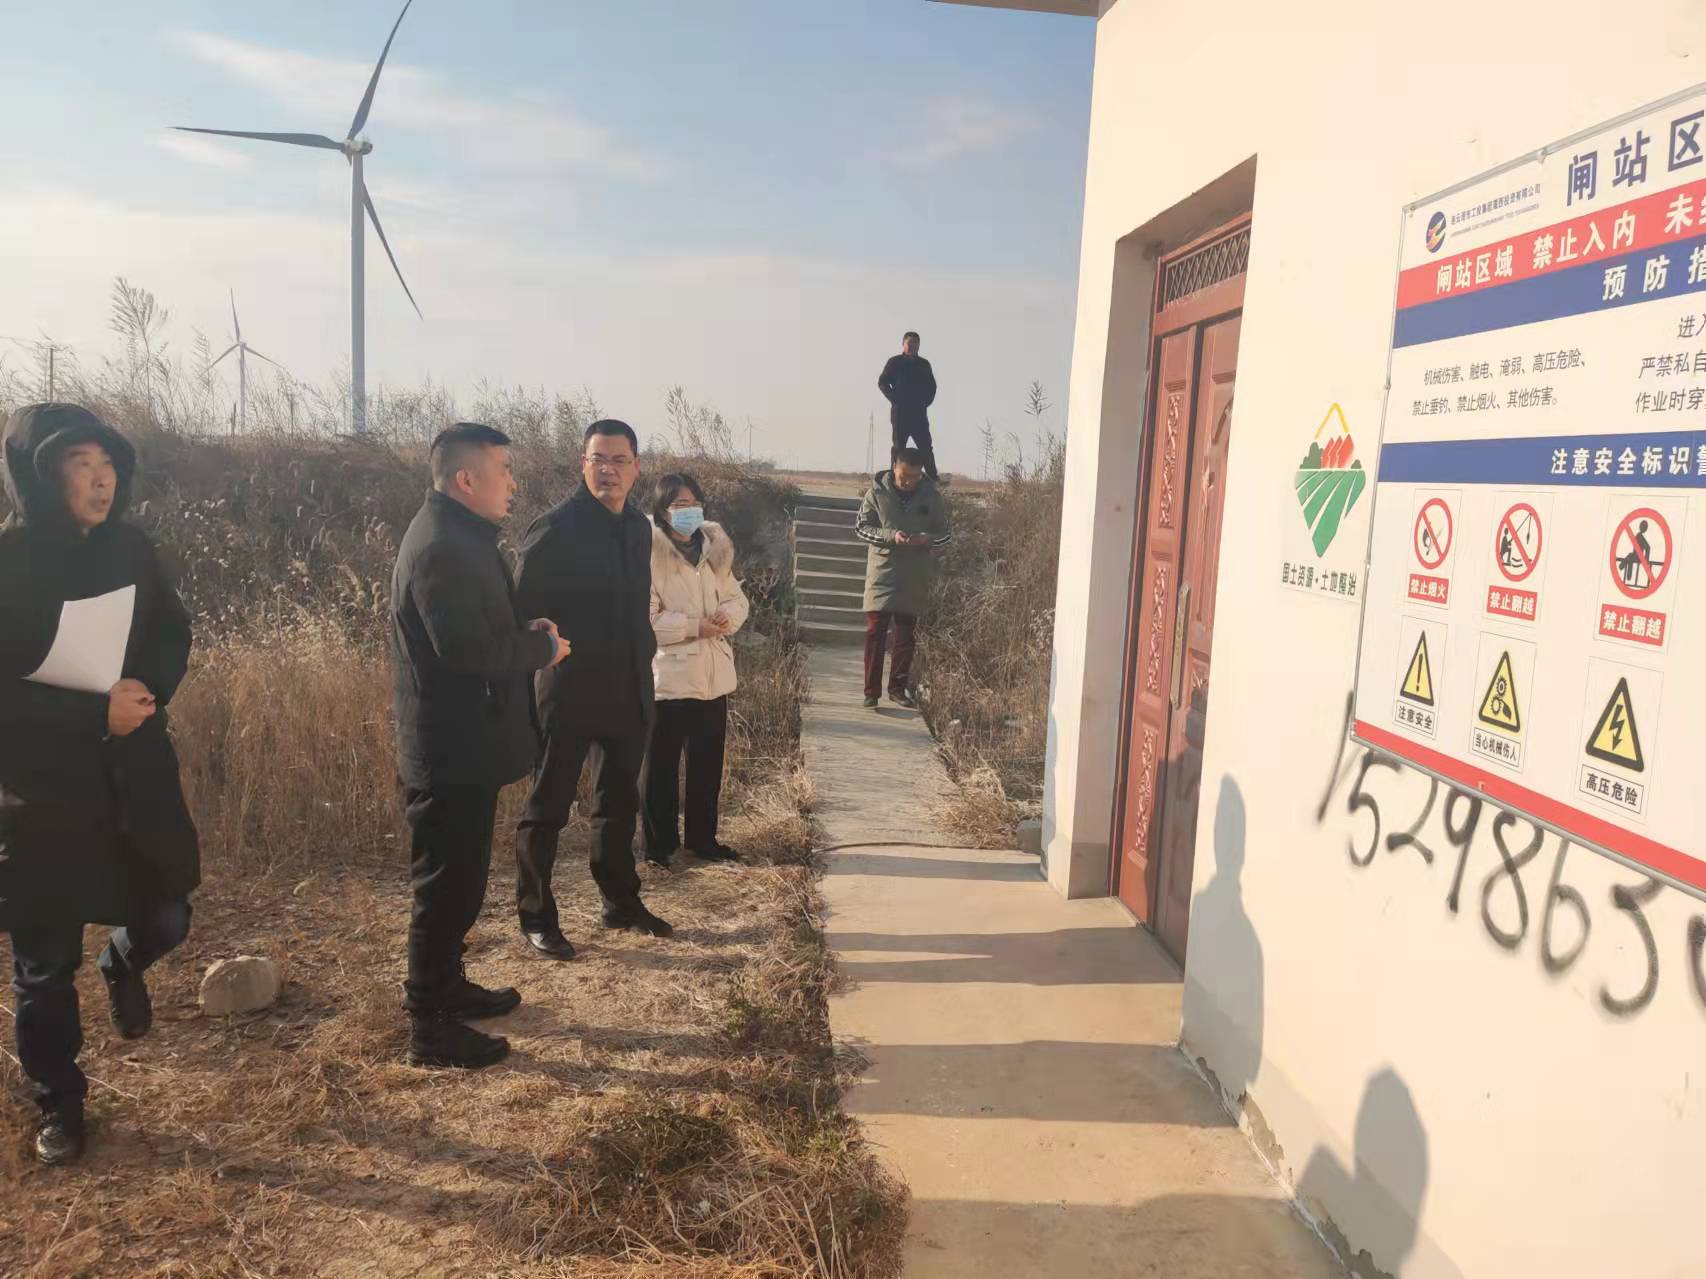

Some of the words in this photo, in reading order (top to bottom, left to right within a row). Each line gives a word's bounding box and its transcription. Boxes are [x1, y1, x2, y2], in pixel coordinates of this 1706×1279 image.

[1436, 246, 1513, 295] 闸站区域
[1532, 210, 1636, 270] 禁止入内
[1635, 386, 1706, 414] 作业时穿
[1410, 577, 1447, 601] 禁止烟火
[1488, 590, 1535, 617] 禁止翻越
[1601, 609, 1663, 641] 禁止翻越
[1398, 704, 1434, 730] 注意安全
[1474, 732, 1518, 762] 当心机械伤人
[1586, 772, 1639, 807] 高压危险
